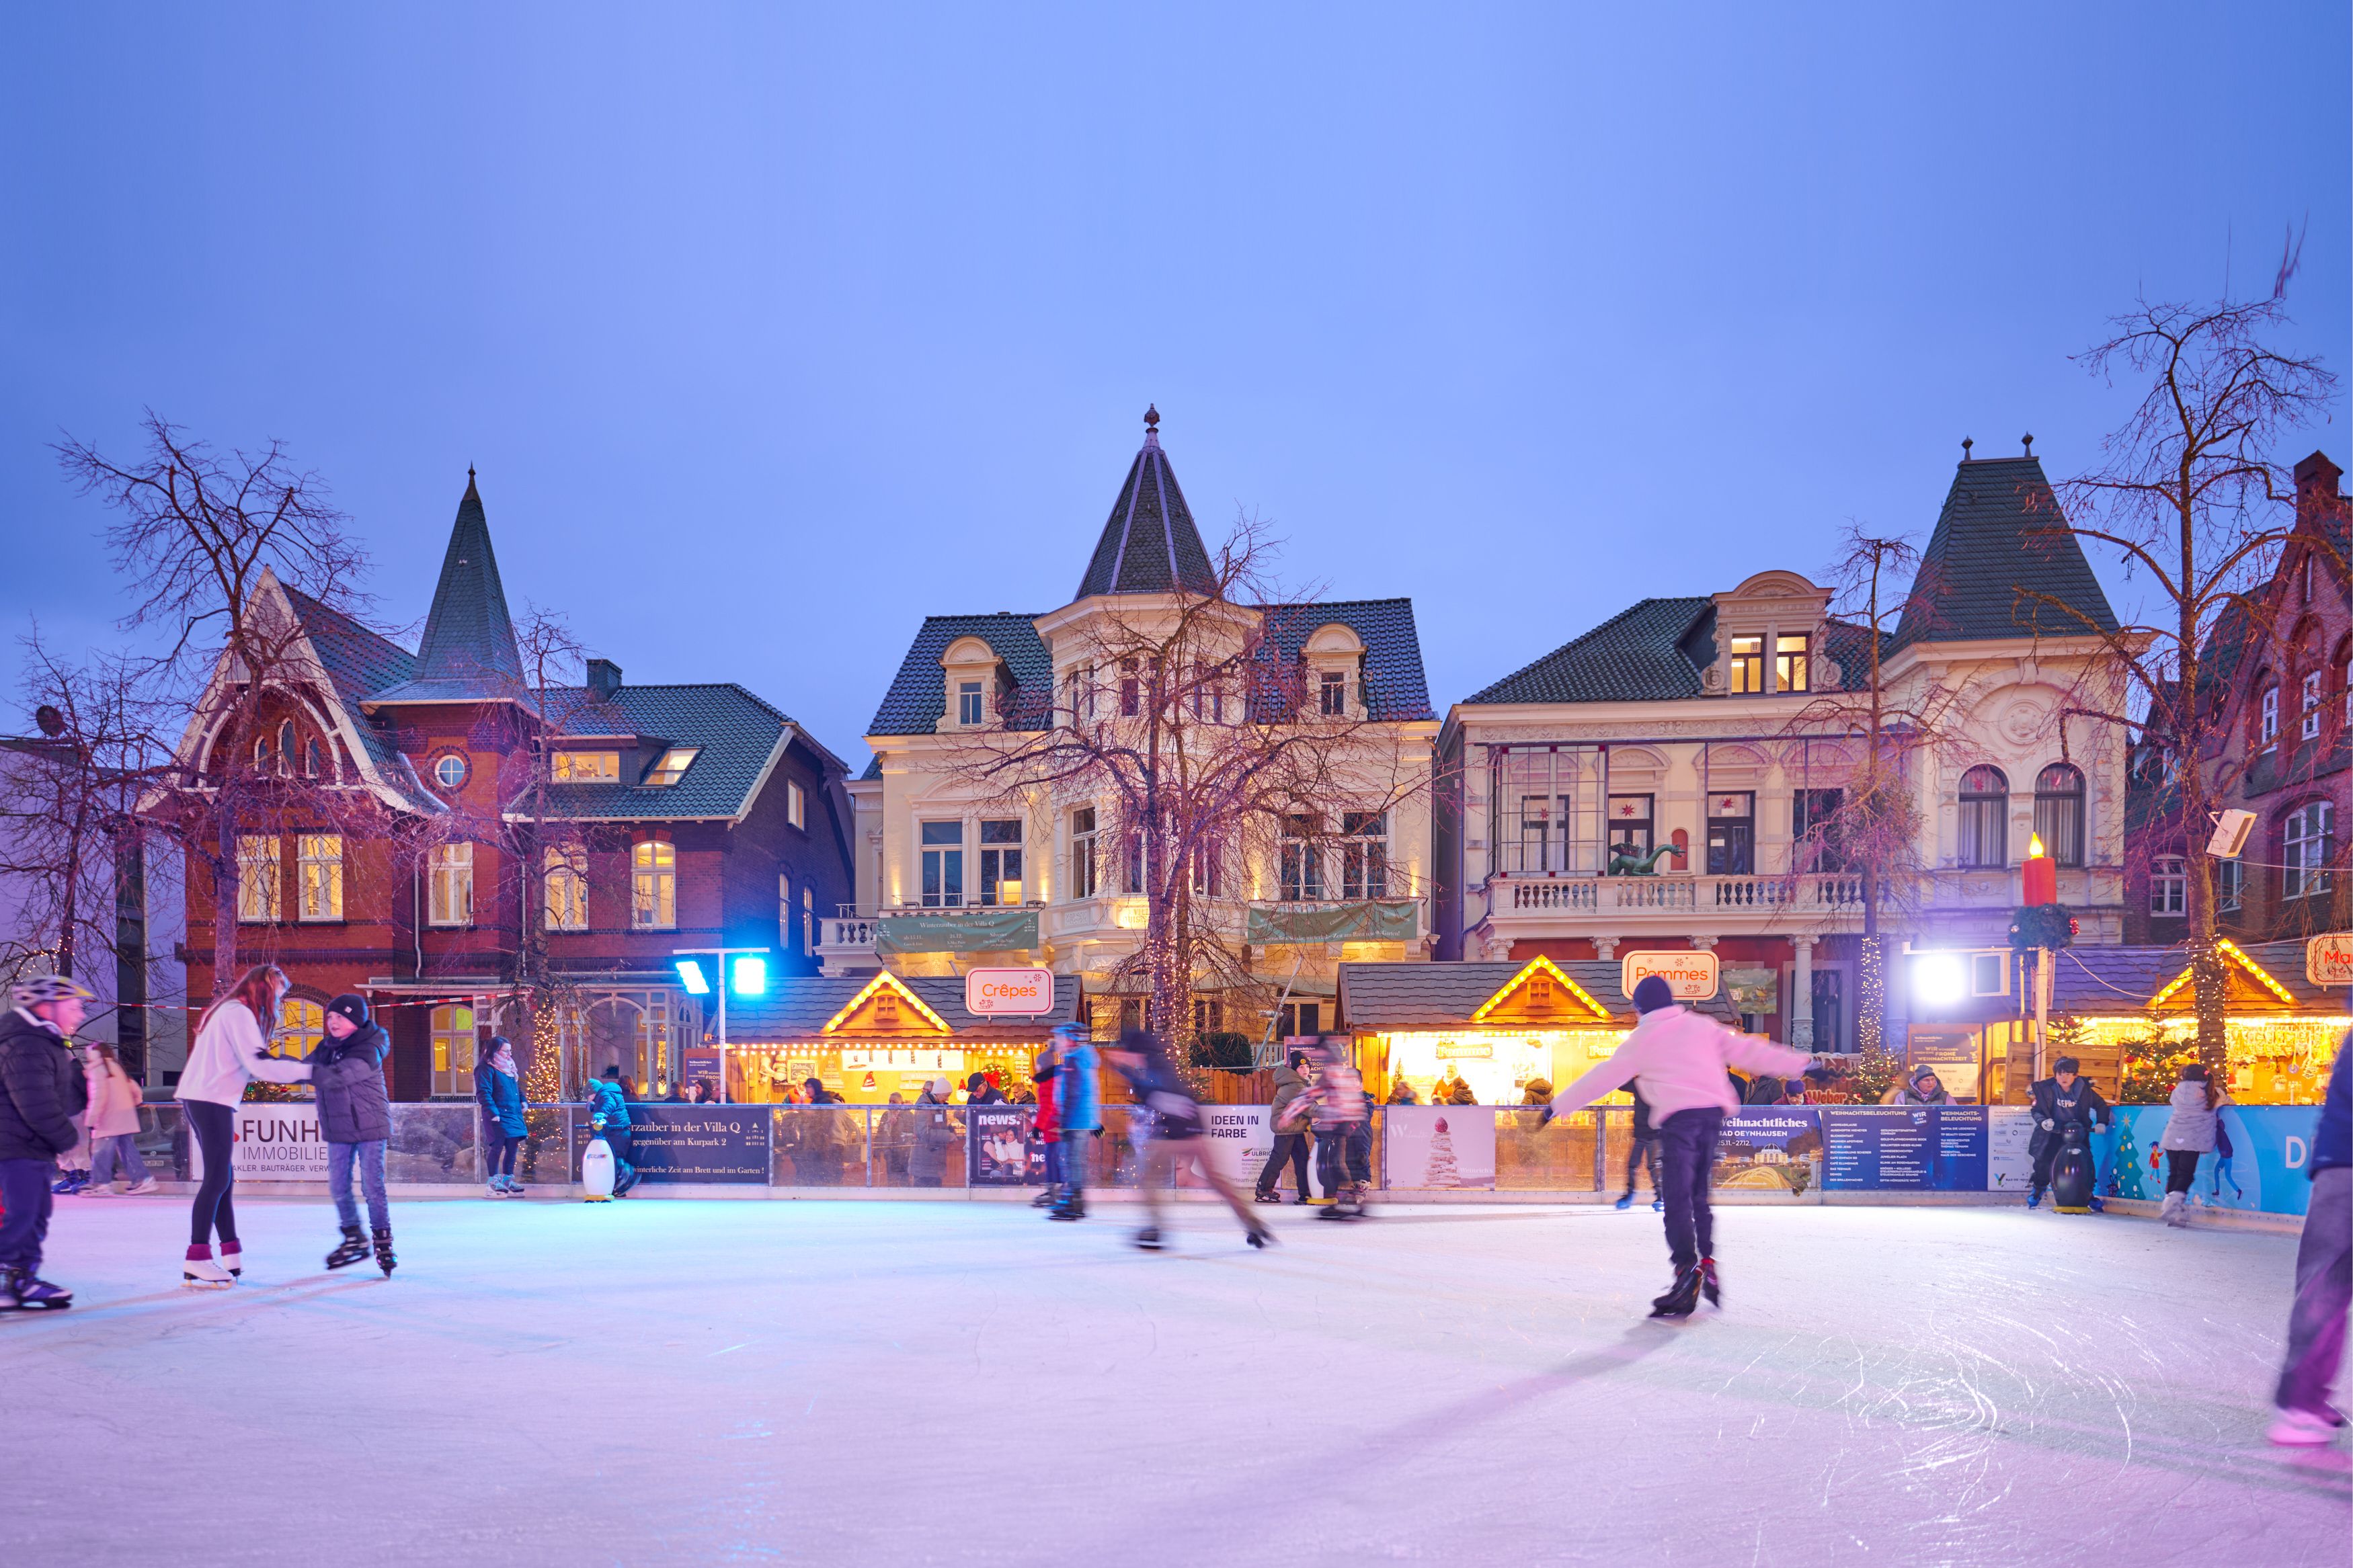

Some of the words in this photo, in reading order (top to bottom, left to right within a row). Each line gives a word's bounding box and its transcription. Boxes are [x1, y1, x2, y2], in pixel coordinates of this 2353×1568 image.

[1636, 967, 1708, 981] Pommes
[982, 983, 1037, 1000] Crêpes
[1437, 1046, 1491, 1057] Pommes
[1806, 1089, 1847, 1104] Weber
[979, 1114, 1021, 1125] news.
[1211, 1116, 1244, 1125] IDEEN
[1248, 1116, 1259, 1125] IN
[243, 1120, 319, 1143] FUNH
[671, 1122, 682, 1132] in
[684, 1122, 701, 1132] der
[704, 1122, 728, 1132] Villa
[729, 1122, 742, 1134] Q
[1211, 1128, 1247, 1138] FARBE
[633, 1137, 672, 1147] gegenüber
[687, 1137, 719, 1147] Kurpark
[721, 1138, 727, 1146] 2
[243, 1147, 327, 1160] IMMOBILIE
[260, 1163, 307, 1172] BAUTRÄGER.
[737, 1166, 760, 1174] Garten
